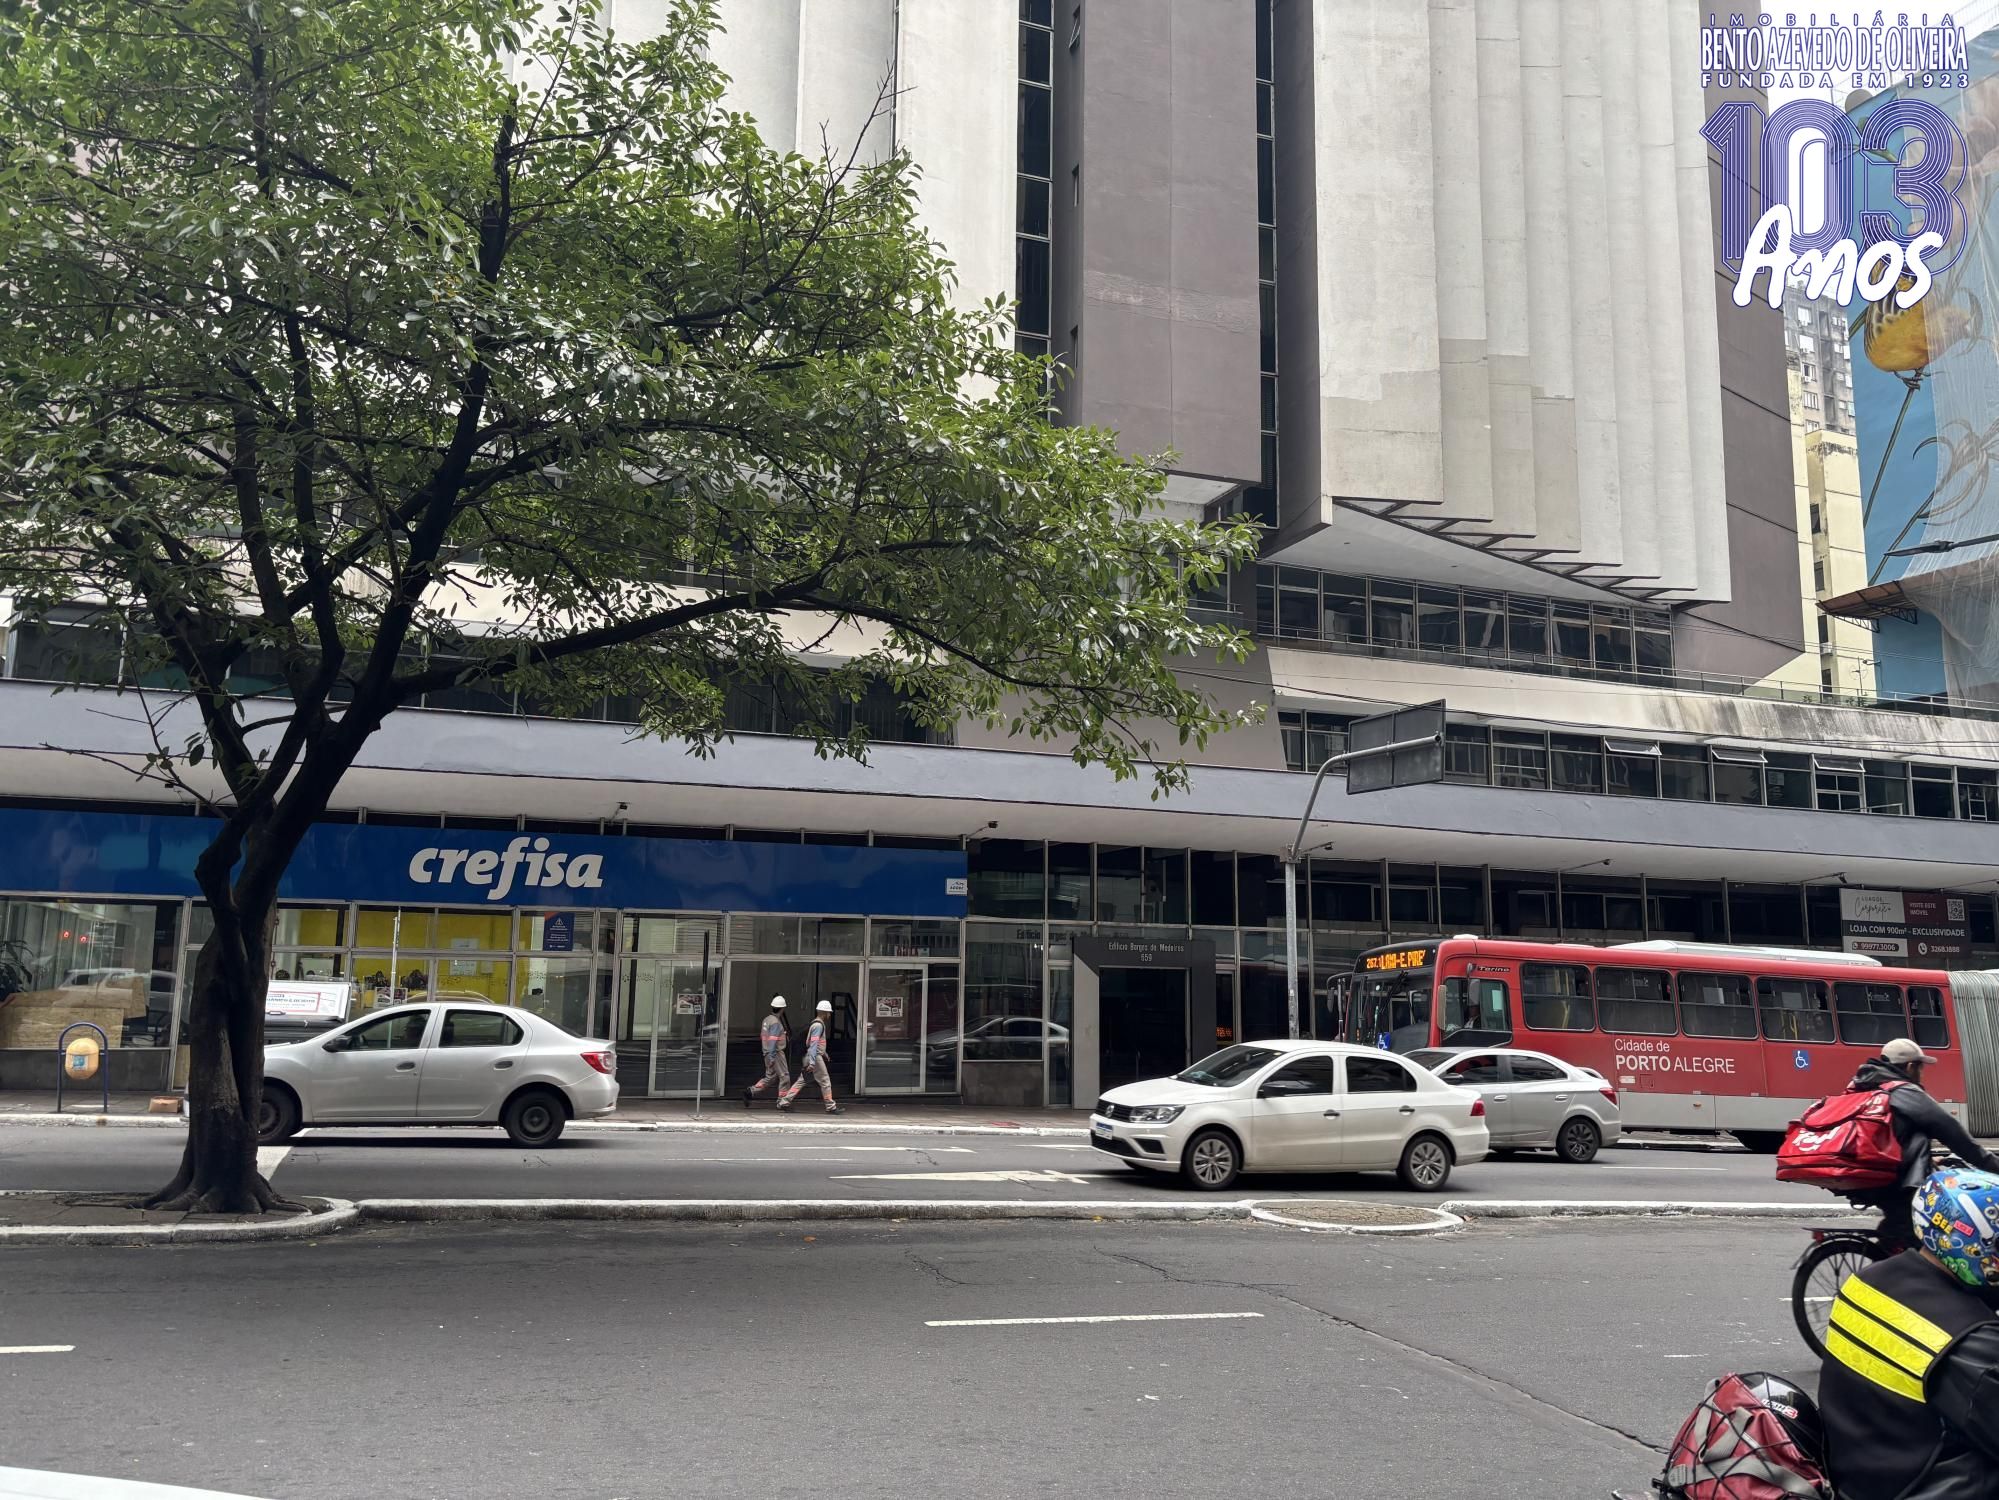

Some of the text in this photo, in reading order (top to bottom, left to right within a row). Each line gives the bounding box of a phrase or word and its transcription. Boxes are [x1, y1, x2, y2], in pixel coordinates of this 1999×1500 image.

[409, 837, 604, 900] crefisa
[1849, 924, 1867, 933] LOJA
[1869, 925, 1885, 934] COM
[1912, 928, 1965, 937] EXCLUSIVIDADE
[1614, 1038, 1670, 1053] Cidade de
[1615, 1054, 1736, 1074] PORTO ALEGRE
[1931, 1211, 1954, 1235] BEE
